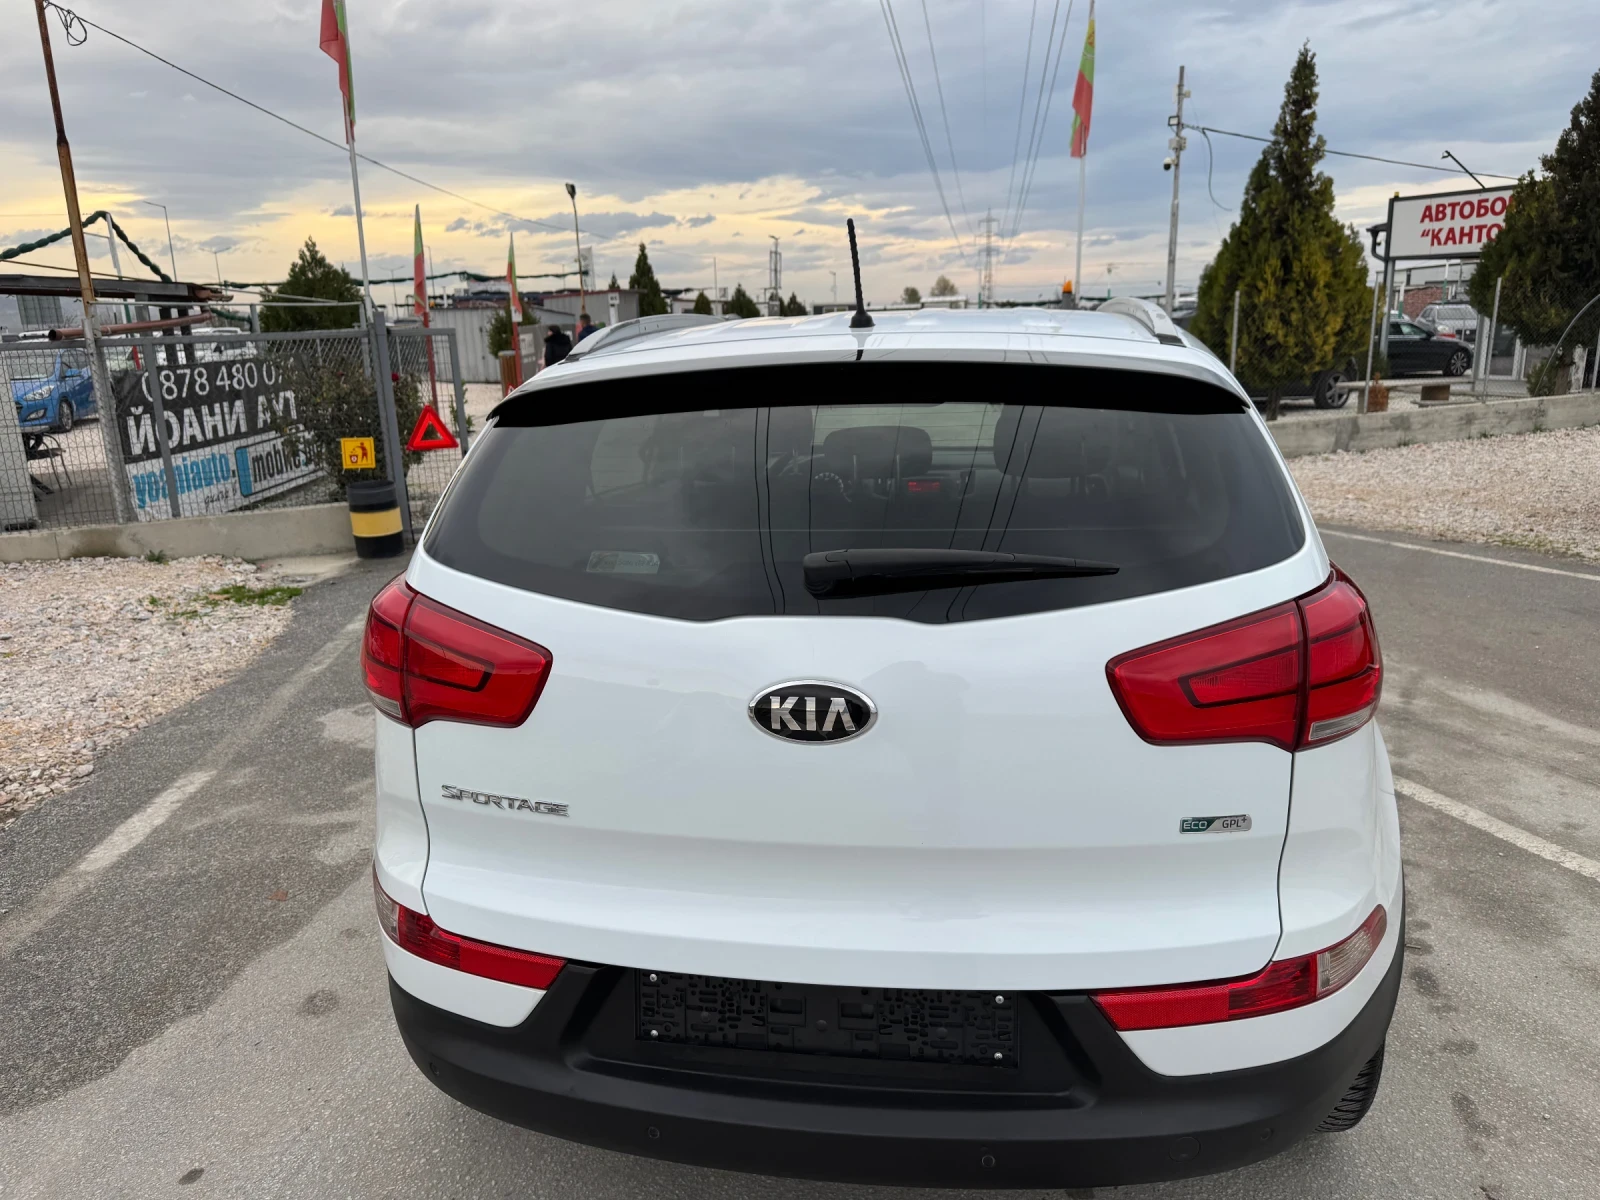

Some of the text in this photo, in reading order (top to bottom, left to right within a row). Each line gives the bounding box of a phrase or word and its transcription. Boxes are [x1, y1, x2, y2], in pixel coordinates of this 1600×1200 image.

[215, 362, 258, 391] 480
[126, 399, 248, 456] ЙОАНИ
[769, 696, 856, 731] KIA
[441, 784, 569, 817] SPORTAGE
[1183, 820, 1208, 830] ECO
